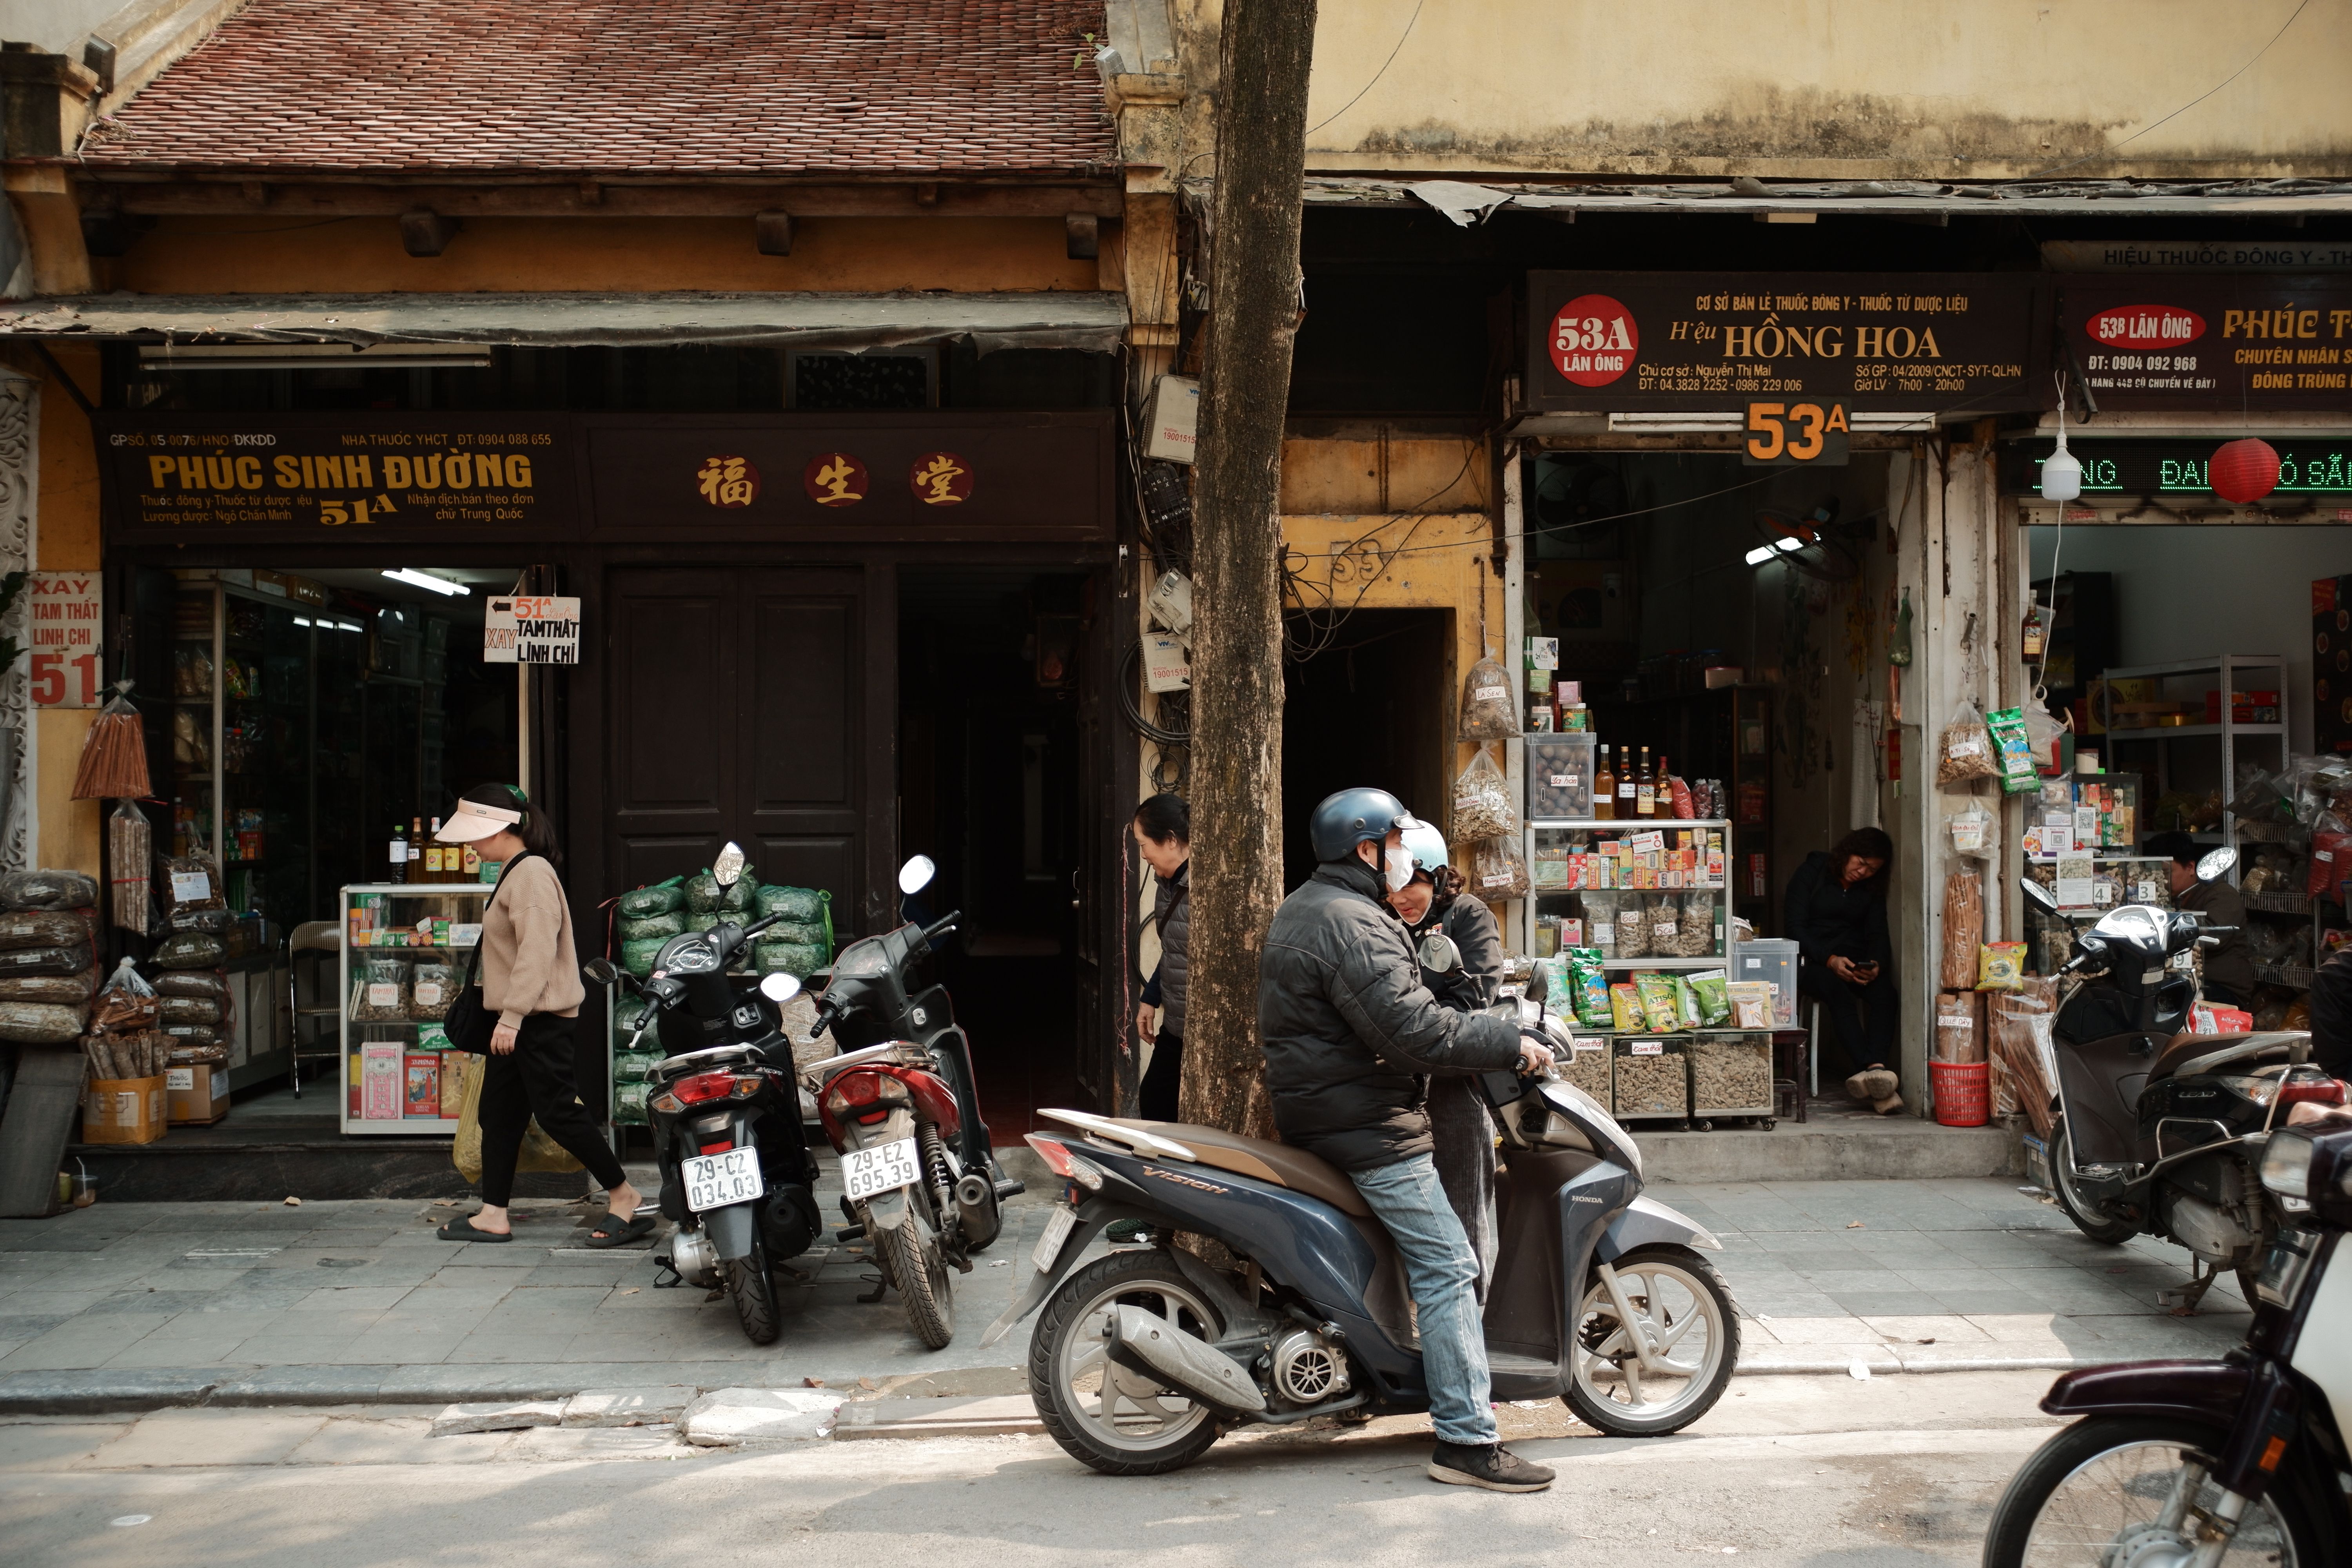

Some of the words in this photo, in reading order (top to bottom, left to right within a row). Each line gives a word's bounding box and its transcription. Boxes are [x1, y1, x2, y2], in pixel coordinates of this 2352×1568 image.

[2105, 246, 2151, 267] HIỆU
[2158, 244, 2227, 264] THUỐC
[2234, 247, 2293, 264] ĐÔNG
[2300, 251, 2313, 264] Y
[1696, 294, 1711, 310] CƠ
[1714, 291, 1729, 310] SỞ
[1733, 292, 1755, 310] BÁN
[1759, 291, 1771, 310] LẺ
[1776, 292, 1808, 311] THUỐC
[1811, 294, 1840, 311] ĐÔNG
[1844, 296, 1851, 311] Y
[1860, 292, 1892, 311] THUỐC
[1896, 294, 1911, 311] TỪ
[1914, 296, 1942, 315] DƯỢC
[1946, 294, 1968, 315] LIỆU
[2099, 317, 2125, 339] 53B
[2129, 313, 2158, 339] LÃN
[2161, 312, 2192, 339] ÔNG
[2222, 301, 2319, 339] PHÚC
[2329, 310, 2352, 339] T
[1556, 316, 1634, 351] 53A
[1669, 321, 1717, 344] Hệu
[1722, 312, 1845, 358] HỒNG
[1853, 326, 1942, 358] HOA
[1564, 354, 1591, 371] LÃN
[1594, 353, 1623, 371] ÔNG
[2088, 356, 2108, 370] ĐT:
[2112, 356, 2143, 370] 0904
[2147, 356, 2170, 371] 092
[2174, 356, 2197, 371] 968
[2235, 346, 2294, 364] CHUYÊN
[2297, 346, 2339, 364] NHÂN
[1639, 363, 1659, 376] Chủ
[1661, 365, 1674, 376] cơ
[1695, 361, 1733, 379] Nguyễn
[1737, 365, 1751, 379] Thị
[1754, 364, 1771, 376] Mai
[1856, 363, 1871, 377] Số
[1639, 378, 1657, 390] ĐT:
[1660, 378, 1700, 391] 04.3828
[1703, 379, 1728, 391] 2252
[1735, 379, 1759, 391] 0986
[1762, 379, 1782, 391] 229
[1784, 379, 1802, 391] 006
[1854, 379, 1872, 391] Giờ
[1898, 379, 1922, 391] 7h00
[1935, 379, 1965, 391] 20h00
[2252, 370, 2294, 389] ĐÔNG
[2297, 370, 2347, 389] TRÙNG
[416, 434, 448, 445] YHCT
[457, 434, 475, 445] ĐT:
[478, 434, 505, 445] 0904
[508, 434, 528, 445] 088
[531, 434, 552, 446] 655
[1163, 432, 1196, 444] 19001515
[1748, 402, 1849, 460] 53A
[148, 449, 263, 490] PHÚC
[273, 454, 373, 490] SINH
[382, 448, 533, 490] ĐƯỜNG
[140, 494, 173, 506] Thuốc
[176, 494, 202, 508] đông
[249, 494, 261, 506] từ
[264, 494, 291, 507] dược
[319, 492, 400, 526] 51A
[408, 493, 436, 507] Nhận
[485, 494, 508, 505] theo
[512, 493, 534, 505] đơn
[142, 510, 180, 524] Lương
[182, 510, 213, 523] dược:
[215, 509, 237, 524] Ngô
[436, 508, 456, 520] chữ
[460, 508, 491, 522] Trung
[496, 506, 524, 520] Quốc
[31, 580, 90, 595] XAY
[33, 603, 61, 620] TAM
[66, 597, 99, 619] THẤT
[33, 628, 64, 645] LINH
[68, 628, 91, 645] CHI
[485, 628, 518, 649] XAY
[1153, 668, 1188, 679] 19001515
[1477, 690, 1486, 699] LÁ
[2095, 888, 2104, 900] 4
[2140, 886, 2149, 899] 3
[2175, 955, 2185, 966] 9
[853, 1142, 904, 1173] 29-E2
[694, 1152, 747, 1183] 29-C2
[850, 1161, 913, 1196] 695.39
[1142, 1165, 1229, 1194] VISION
[691, 1174, 757, 1207] 034.03
[1572, 1195, 1603, 1204] HONDA
